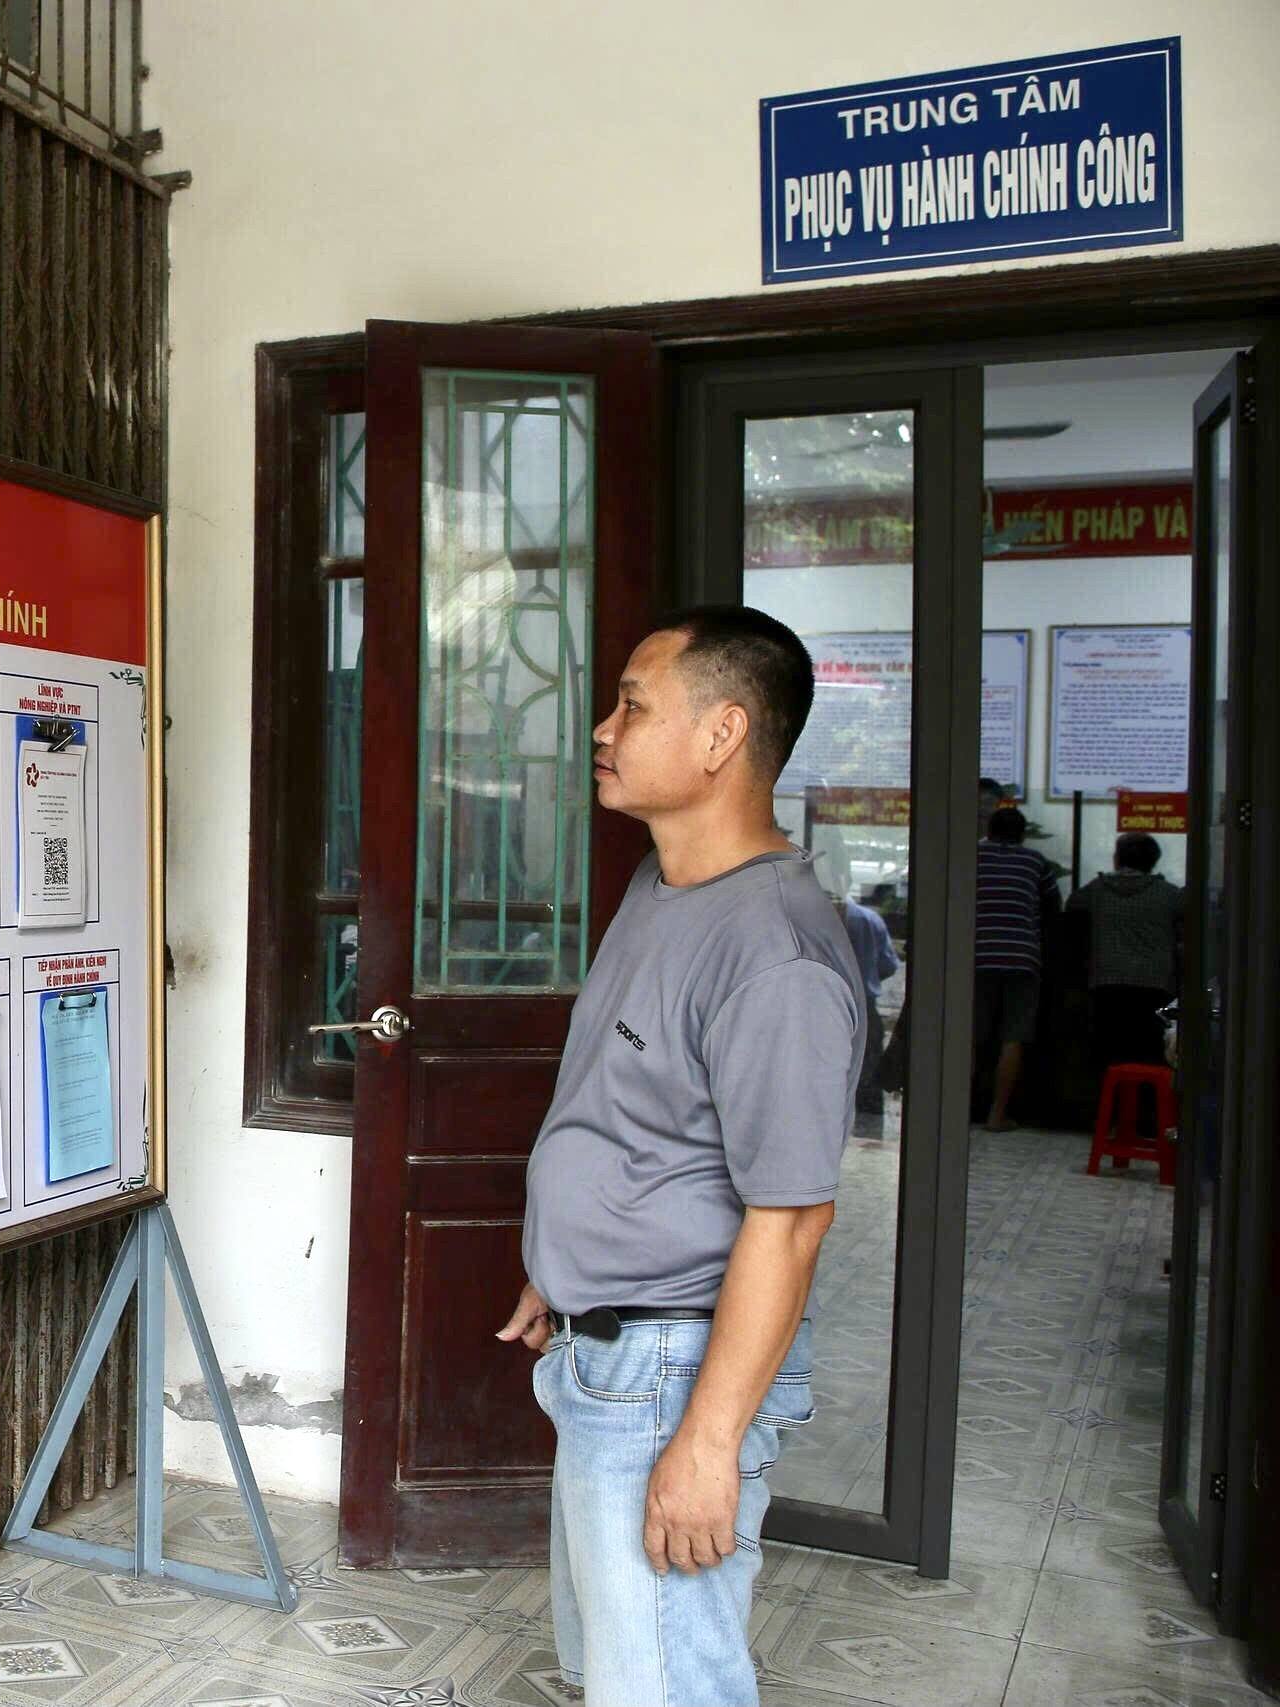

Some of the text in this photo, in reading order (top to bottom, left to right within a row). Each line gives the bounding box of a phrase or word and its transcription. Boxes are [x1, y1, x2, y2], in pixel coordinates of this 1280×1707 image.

[837, 75, 1081, 139] TRUNG TÂM
[784, 123, 1156, 253] PHỤC VỤ HÀNH CHÍNH CÔNG
[1072, 497, 1145, 542] PHÁP
[1152, 496, 1188, 539] VÀ
[615, 1019, 647, 1052] sports
